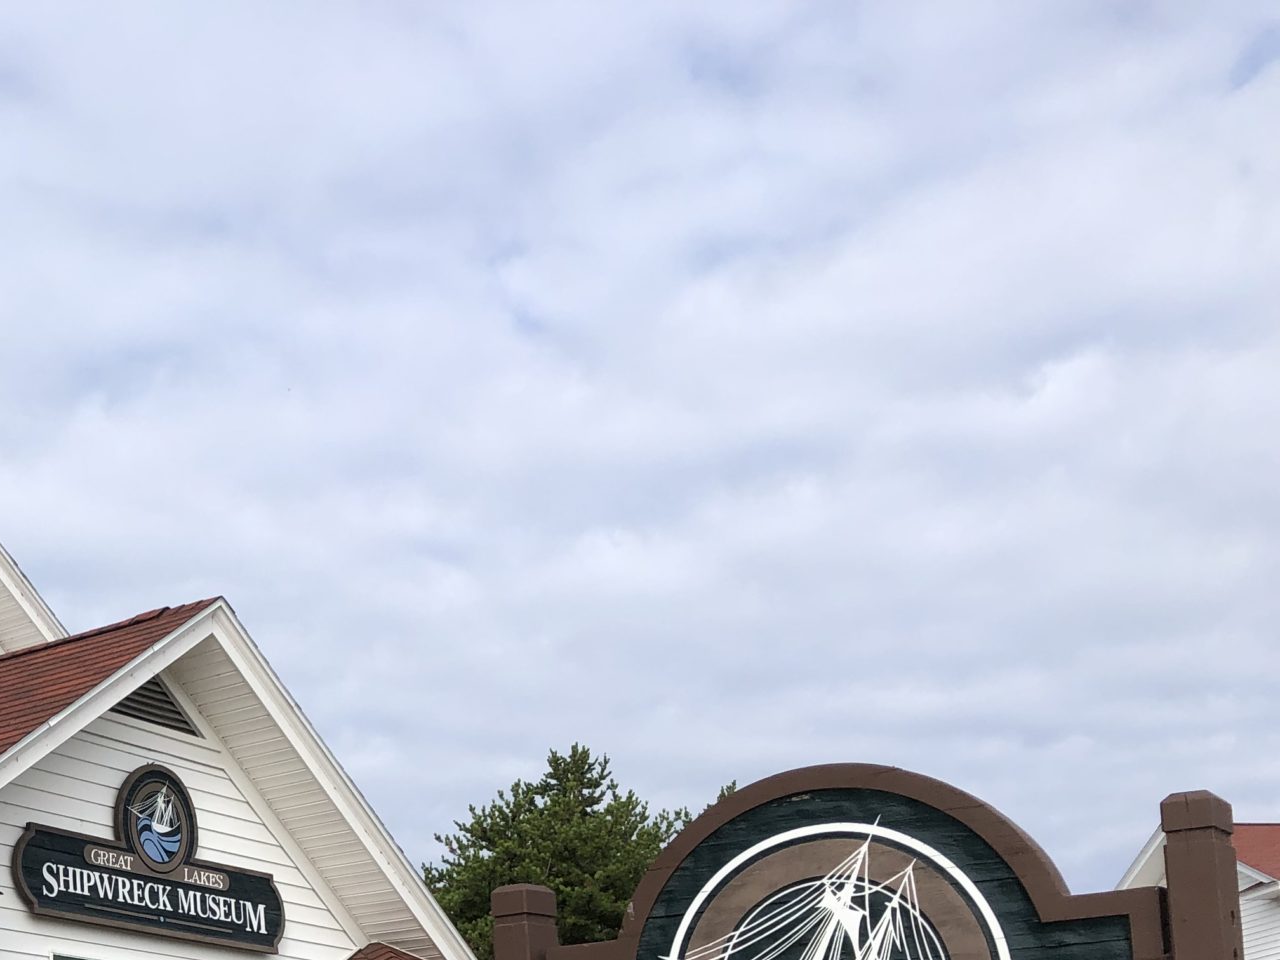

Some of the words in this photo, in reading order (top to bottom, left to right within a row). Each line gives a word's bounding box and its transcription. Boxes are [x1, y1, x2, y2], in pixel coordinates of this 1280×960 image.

[90, 848, 133, 870] GREAT
[184, 868, 224, 889] LAKES
[42, 862, 172, 911] SHIPWRECK
[177, 888, 268, 934] MUSEUM
